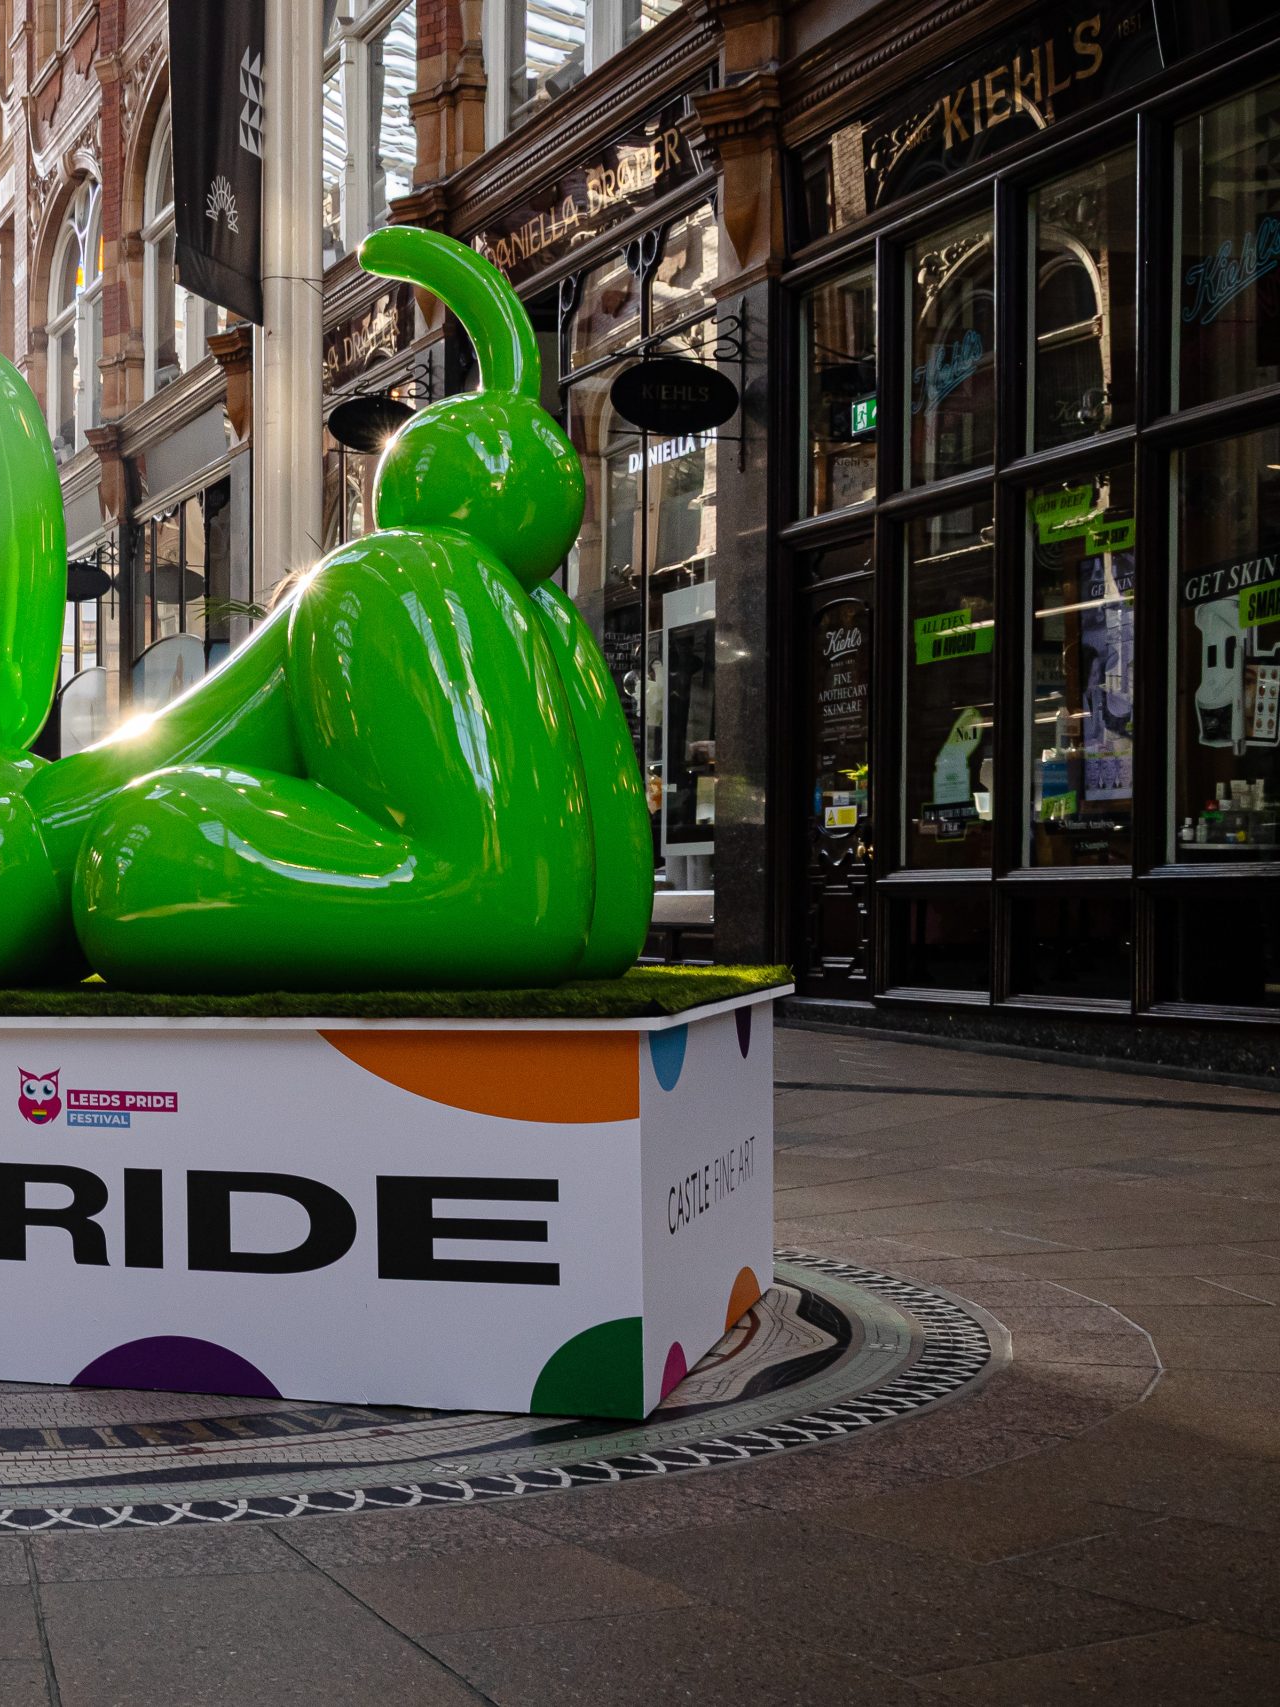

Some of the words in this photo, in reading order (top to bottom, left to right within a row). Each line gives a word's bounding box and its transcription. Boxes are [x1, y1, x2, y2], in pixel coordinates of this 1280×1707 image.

[941, 14, 1104, 151] KIEHL'S
[587, 127, 681, 217] DRAPER
[1185, 569, 1225, 601] GET
[1227, 554, 1278, 590] SKIN
[823, 627, 862, 657] Kiehl's
[833, 671, 852, 686] FINE
[818, 683, 868, 703] APOTHECARY
[823, 700, 863, 717] SKINCARE
[70, 1093, 121, 1107] LEEDS
[125, 1094, 175, 1109] PRIDE
[70, 1113, 129, 1125] FESTIVAL
[667, 1165, 710, 1236] CASTLE
[713, 1149, 735, 1204] FINE
[737, 1136, 756, 1183] ART
